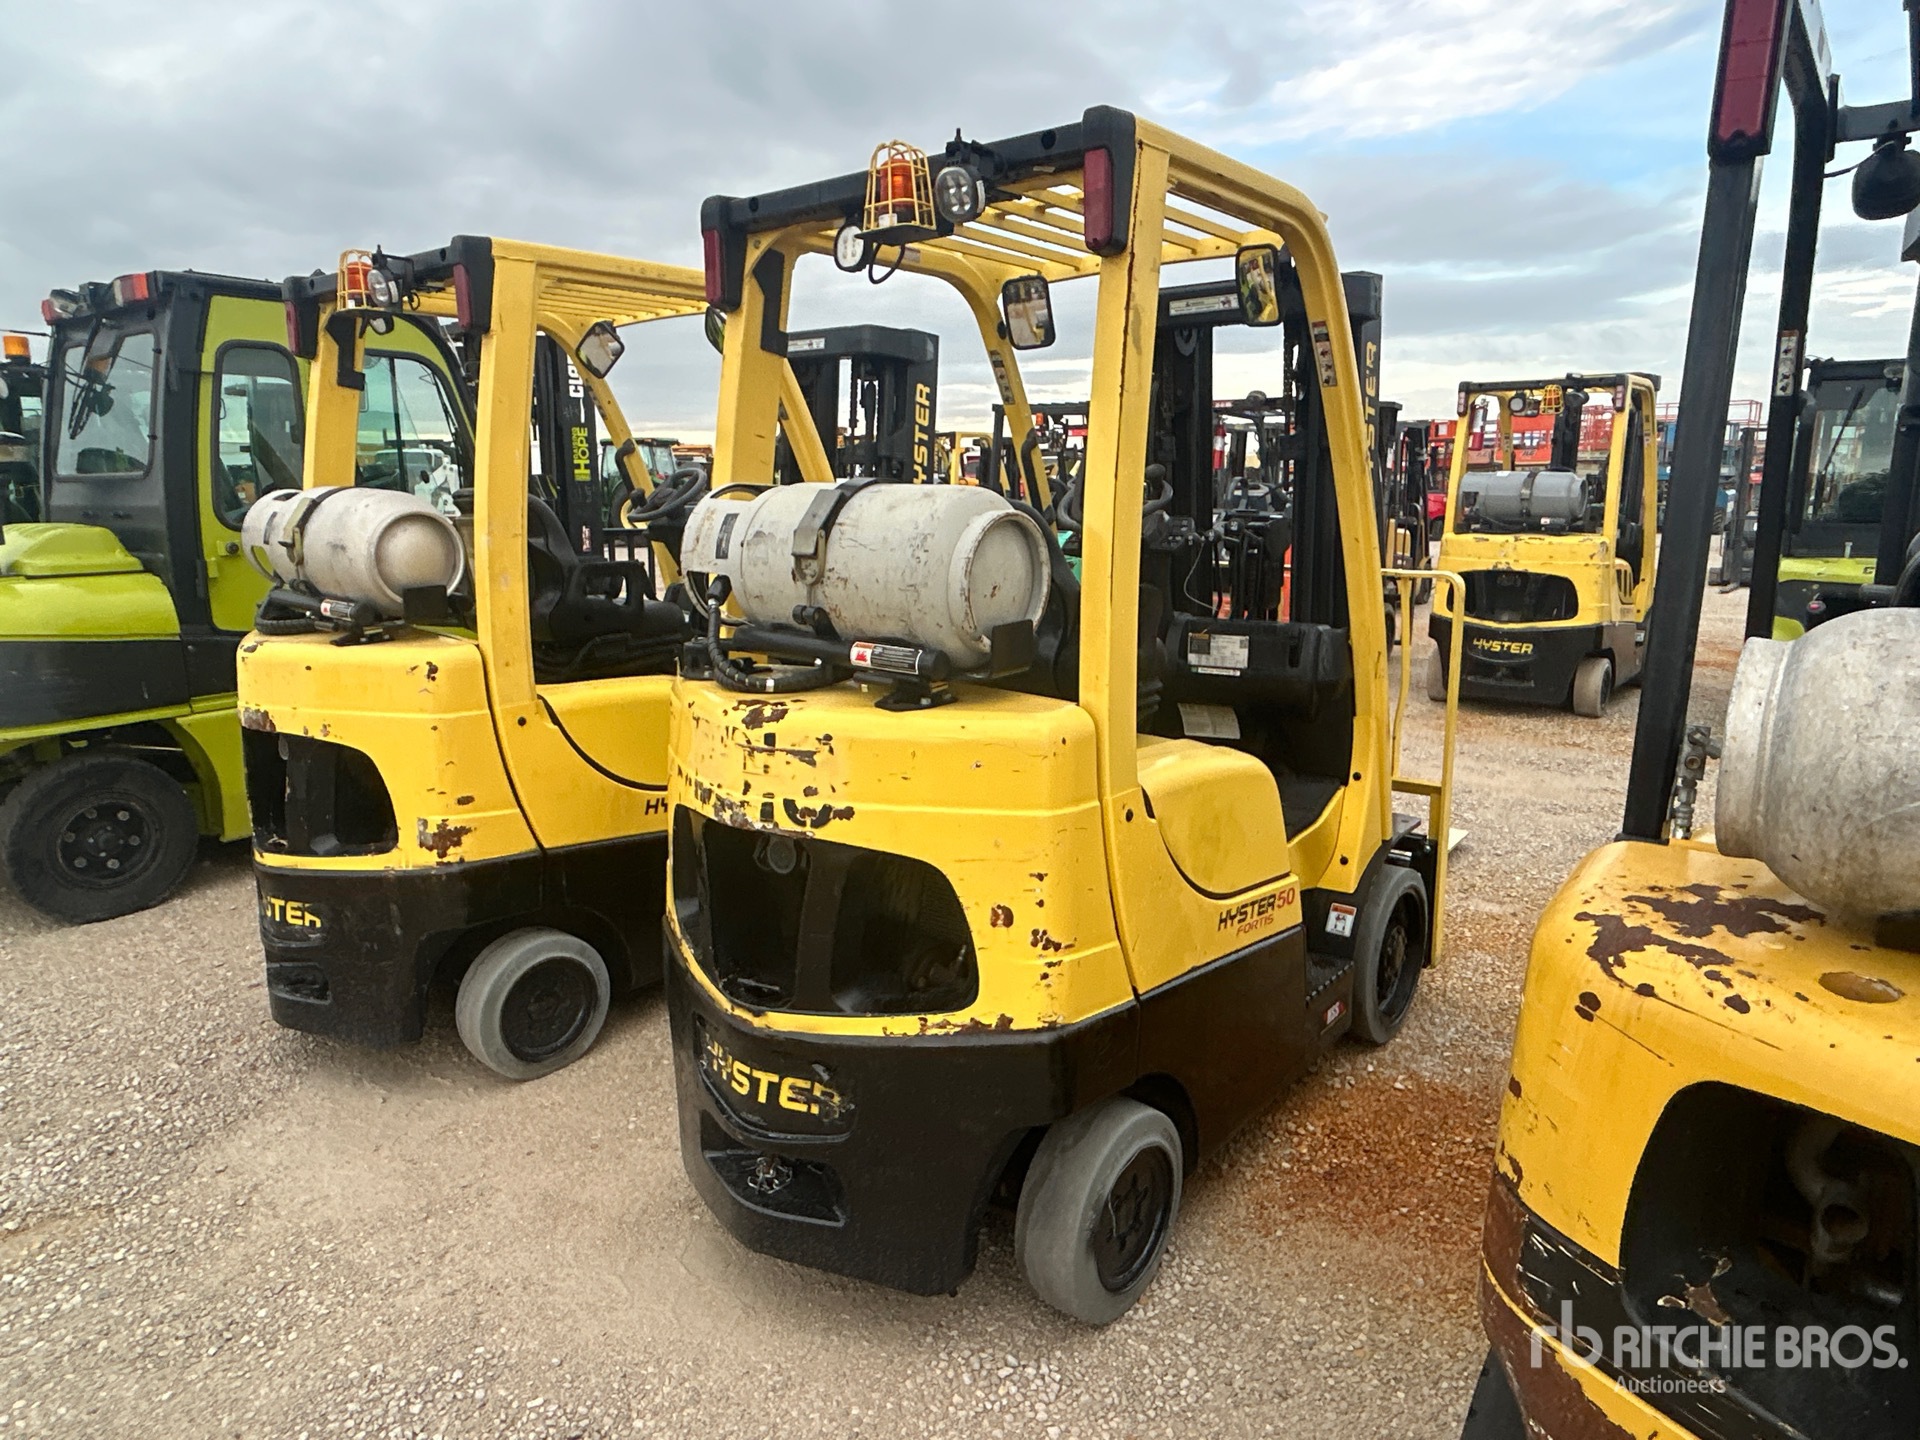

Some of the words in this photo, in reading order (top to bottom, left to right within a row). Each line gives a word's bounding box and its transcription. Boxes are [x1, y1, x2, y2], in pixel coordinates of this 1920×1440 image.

[574, 427, 591, 474] HOPE
[1217, 893, 1276, 932] HYSTER
[1276, 887, 1296, 909] 50
[1236, 913, 1274, 937] FORTIS
